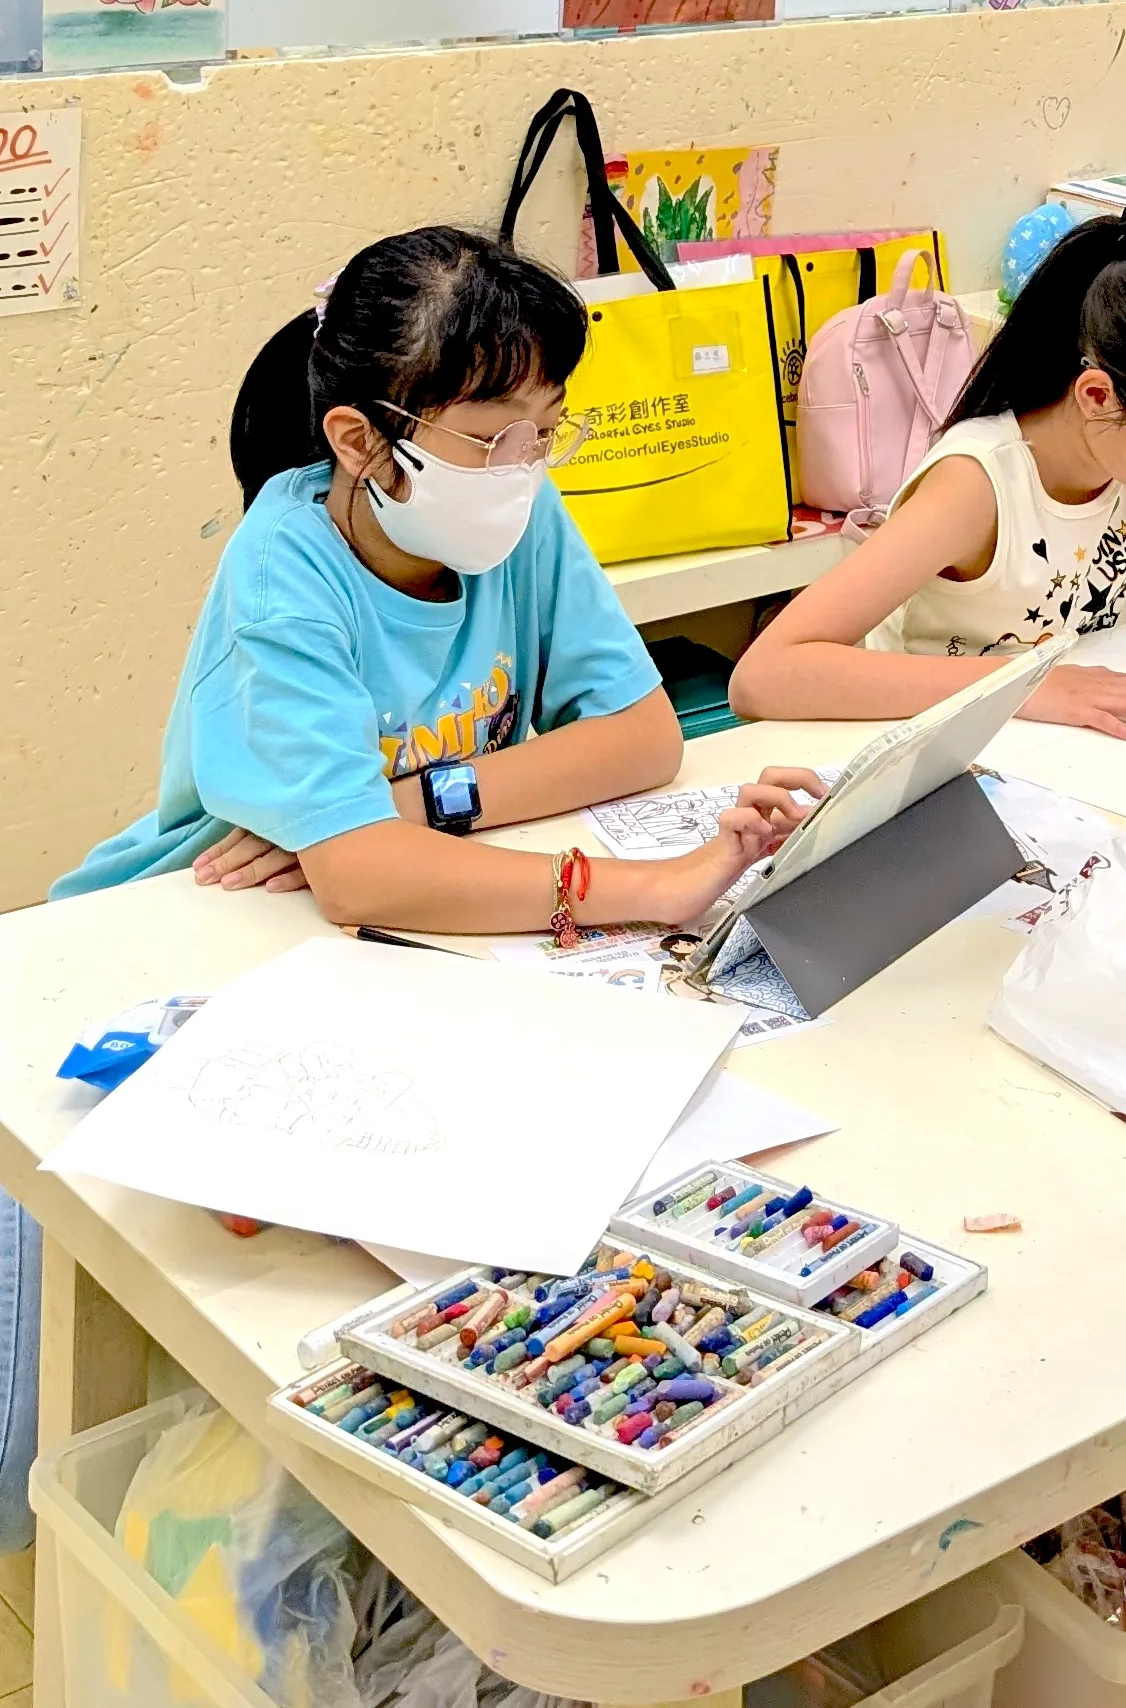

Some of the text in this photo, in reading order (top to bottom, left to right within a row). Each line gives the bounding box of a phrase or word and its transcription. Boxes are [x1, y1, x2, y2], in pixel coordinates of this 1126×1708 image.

[584, 393, 691, 426] 奇彩創作室
